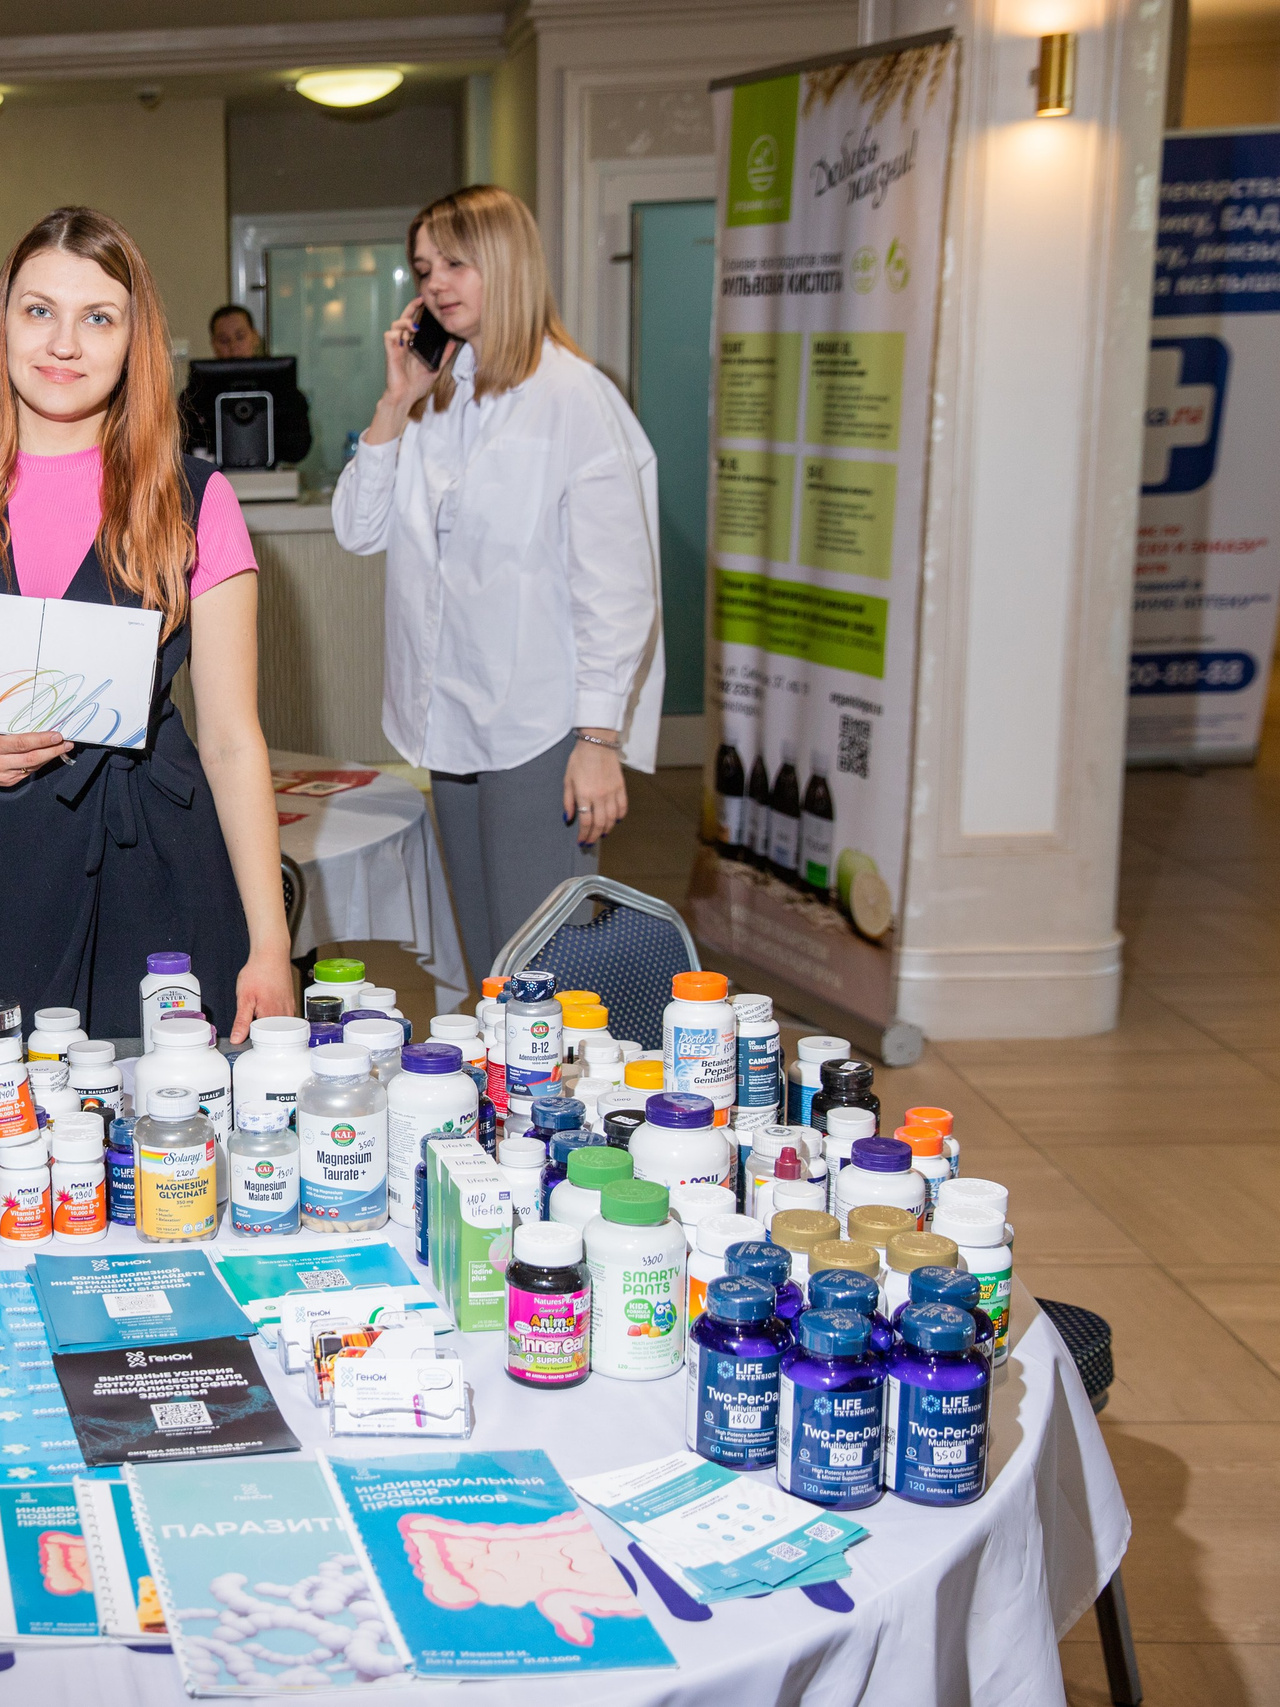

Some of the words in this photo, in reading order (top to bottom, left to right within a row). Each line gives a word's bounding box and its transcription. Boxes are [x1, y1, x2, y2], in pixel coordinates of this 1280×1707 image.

[678, 1032, 715, 1044] Doctor's
[531, 1042, 549, 1053] B-12
[680, 1043, 720, 1056] BEST
[701, 1059, 730, 1068] Betaine
[748, 1056, 776, 1065] CANDIDA
[704, 1066, 733, 1077] Pepsin
[334, 1131, 353, 1139] KAL
[357, 1136, 376, 1151] 3500
[163, 1151, 204, 1165] Solaray
[316, 1150, 372, 1166] Magnesium
[175, 1168, 195, 1177] 2200
[322, 1166, 359, 1181] Taurate
[156, 1179, 209, 1191] MAGNESIUM
[244, 1180, 287, 1192] Magnesium
[159, 1187, 208, 1199] GLYCINATE
[248, 1192, 270, 1201] Malate
[270, 1191, 283, 1200] 400
[72, 1273, 119, 1281] БОЛЬШЕ
[120, 1267, 181, 1279] ПОЛЕЗНОЙ
[471, 1274, 487, 1283] plus
[622, 1265, 680, 1283] SMARTY
[50, 1278, 132, 1287] ИНФОРМАЦИИ
[86, 1281, 127, 1290] НАШЕМ
[128, 1278, 184, 1288] ПРОФИЛЕ
[622, 1281, 671, 1295] PANTS
[72, 1286, 136, 1295] INSTAGRAM
[629, 1302, 649, 1310] KIDS
[533, 1325, 575, 1334] PARADE
[520, 1334, 562, 1355] Inner
[536, 1355, 573, 1364] SUPPORT
[735, 1363, 763, 1374] LIFE
[94, 1376, 214, 1389] СОТРУДНИЧЕСТВА
[215, 1373, 243, 1383] ДЛЯ
[98, 1371, 172, 1383] ВЫГОДНЫЕ
[173, 1367, 235, 1378] УСЛОВИЯ
[735, 1372, 777, 1381] EXTENSION
[92, 1382, 199, 1396] СПЕЦИАЛИСТОВ
[200, 1379, 249, 1390] СФЕРЫ
[138, 1388, 209, 1400] ЗДОРОВЬЯ
[707, 1385, 779, 1405] Two-Per-Da
[723, 1403, 769, 1413] Multivitamin
[834, 1398, 862, 1410] LIFE
[942, 1396, 970, 1408] LIFE
[834, 1406, 876, 1417] EXTENSION
[942, 1403, 982, 1415] EXTENSION
[731, 1413, 756, 1424] 1800
[802, 1422, 881, 1442] Two-Per-Day
[909, 1421, 986, 1439] Two-Per-Day
[821, 1440, 868, 1449] Multivitamin
[928, 1438, 975, 1447] Multivitamin
[710, 1444, 721, 1453] 60
[722, 1450, 743, 1458] TABLETS
[831, 1451, 858, 1463] 3500
[935, 1449, 962, 1461] 3500
[354, 1474, 544, 1495] ИНДИВИДУАЛЬНЫЙ
[802, 1482, 819, 1493] 120
[908, 1481, 925, 1491] 120
[357, 1488, 439, 1503] ПОДБОР
[362, 1493, 508, 1512] ПРОБИОТИКОВ
[16, 1512, 76, 1520] ПОДБОР
